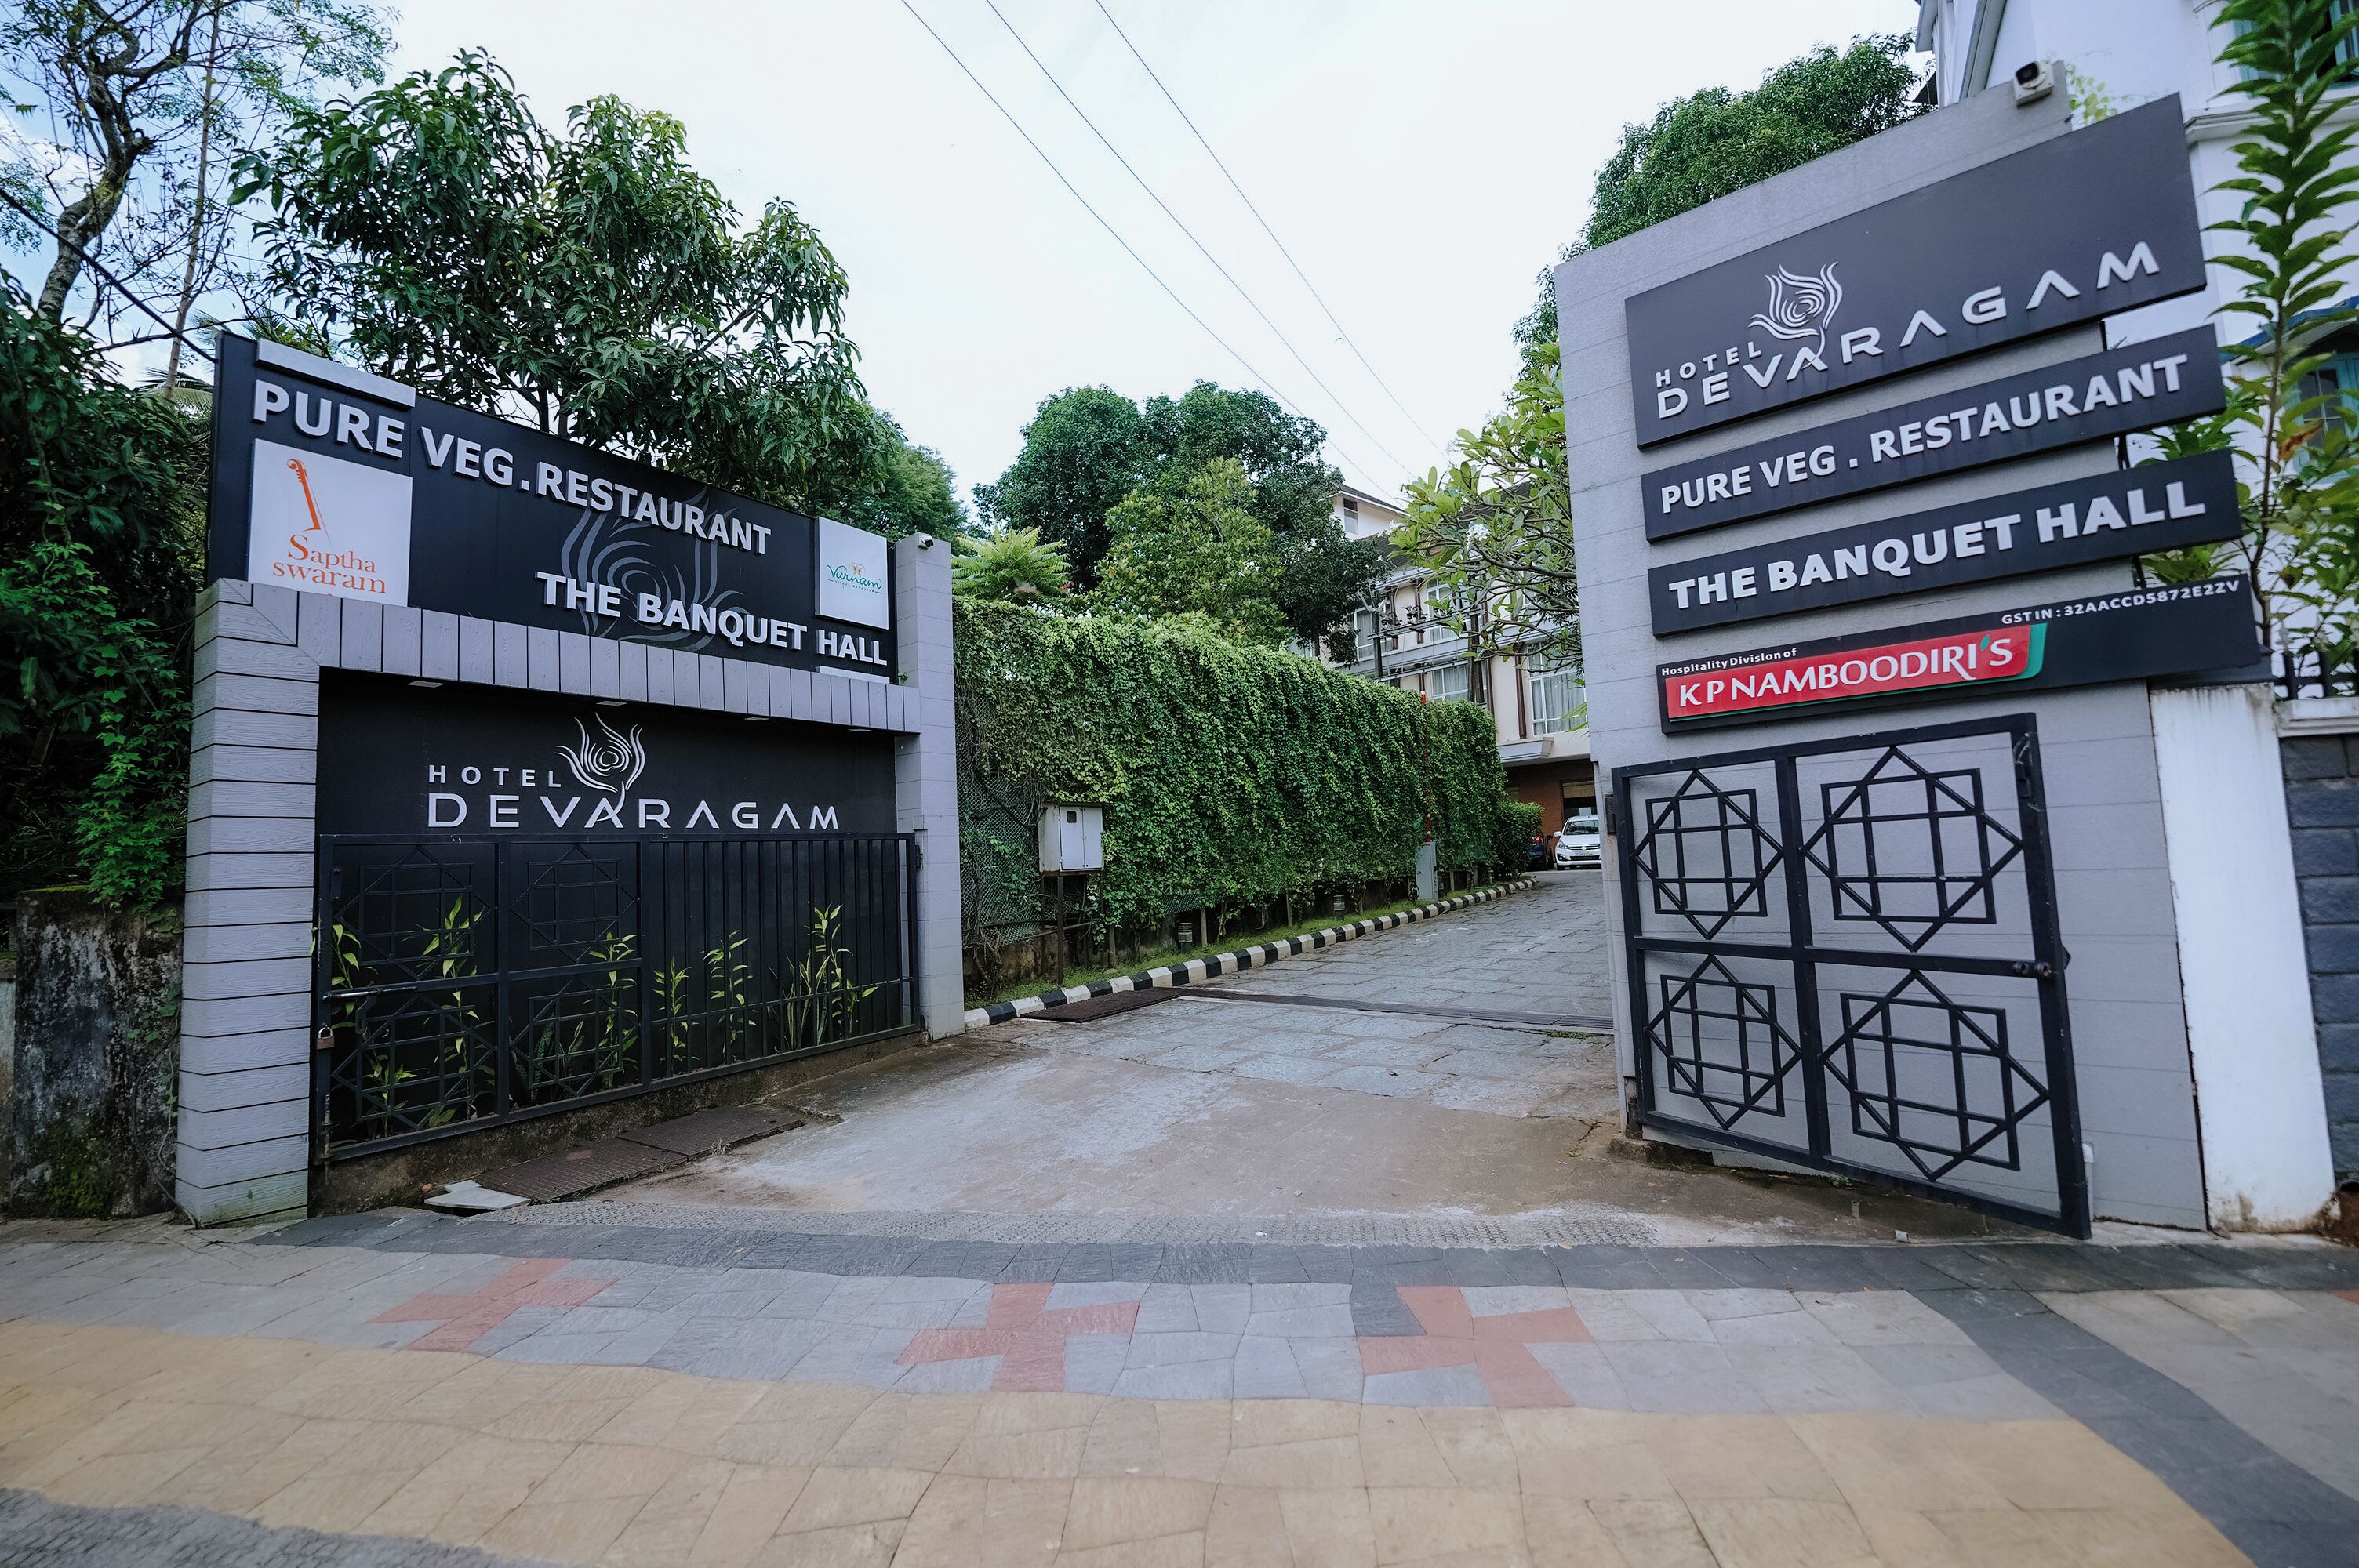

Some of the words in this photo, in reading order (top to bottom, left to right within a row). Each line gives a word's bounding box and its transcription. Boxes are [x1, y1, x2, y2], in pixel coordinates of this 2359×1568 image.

[1657, 240, 2161, 419] DEVARAGAM
[1656, 341, 1761, 388] HOTEL
[1661, 466, 1752, 514] PURE
[1870, 353, 2187, 463] RESTAURANT
[253, 379, 405, 459] PURE
[536, 461, 771, 555] RESTAURANT
[288, 534, 377, 573] Saptha
[1668, 566, 1757, 609] THE
[1768, 513, 2021, 592] BANQUET
[2036, 481, 2205, 543] HALL
[272, 561, 387, 594] swaram
[826, 564, 882, 590] Varnam
[534, 572, 622, 619] THE
[638, 593, 808, 651] BANQUET
[817, 630, 888, 666] HALL
[1662, 659, 1728, 677] Hospitality
[1729, 652, 1781, 666] Division
[1783, 648, 1797, 658] of
[428, 764, 562, 788] HOTEL
[427, 792, 840, 829] DEVARAGAM
